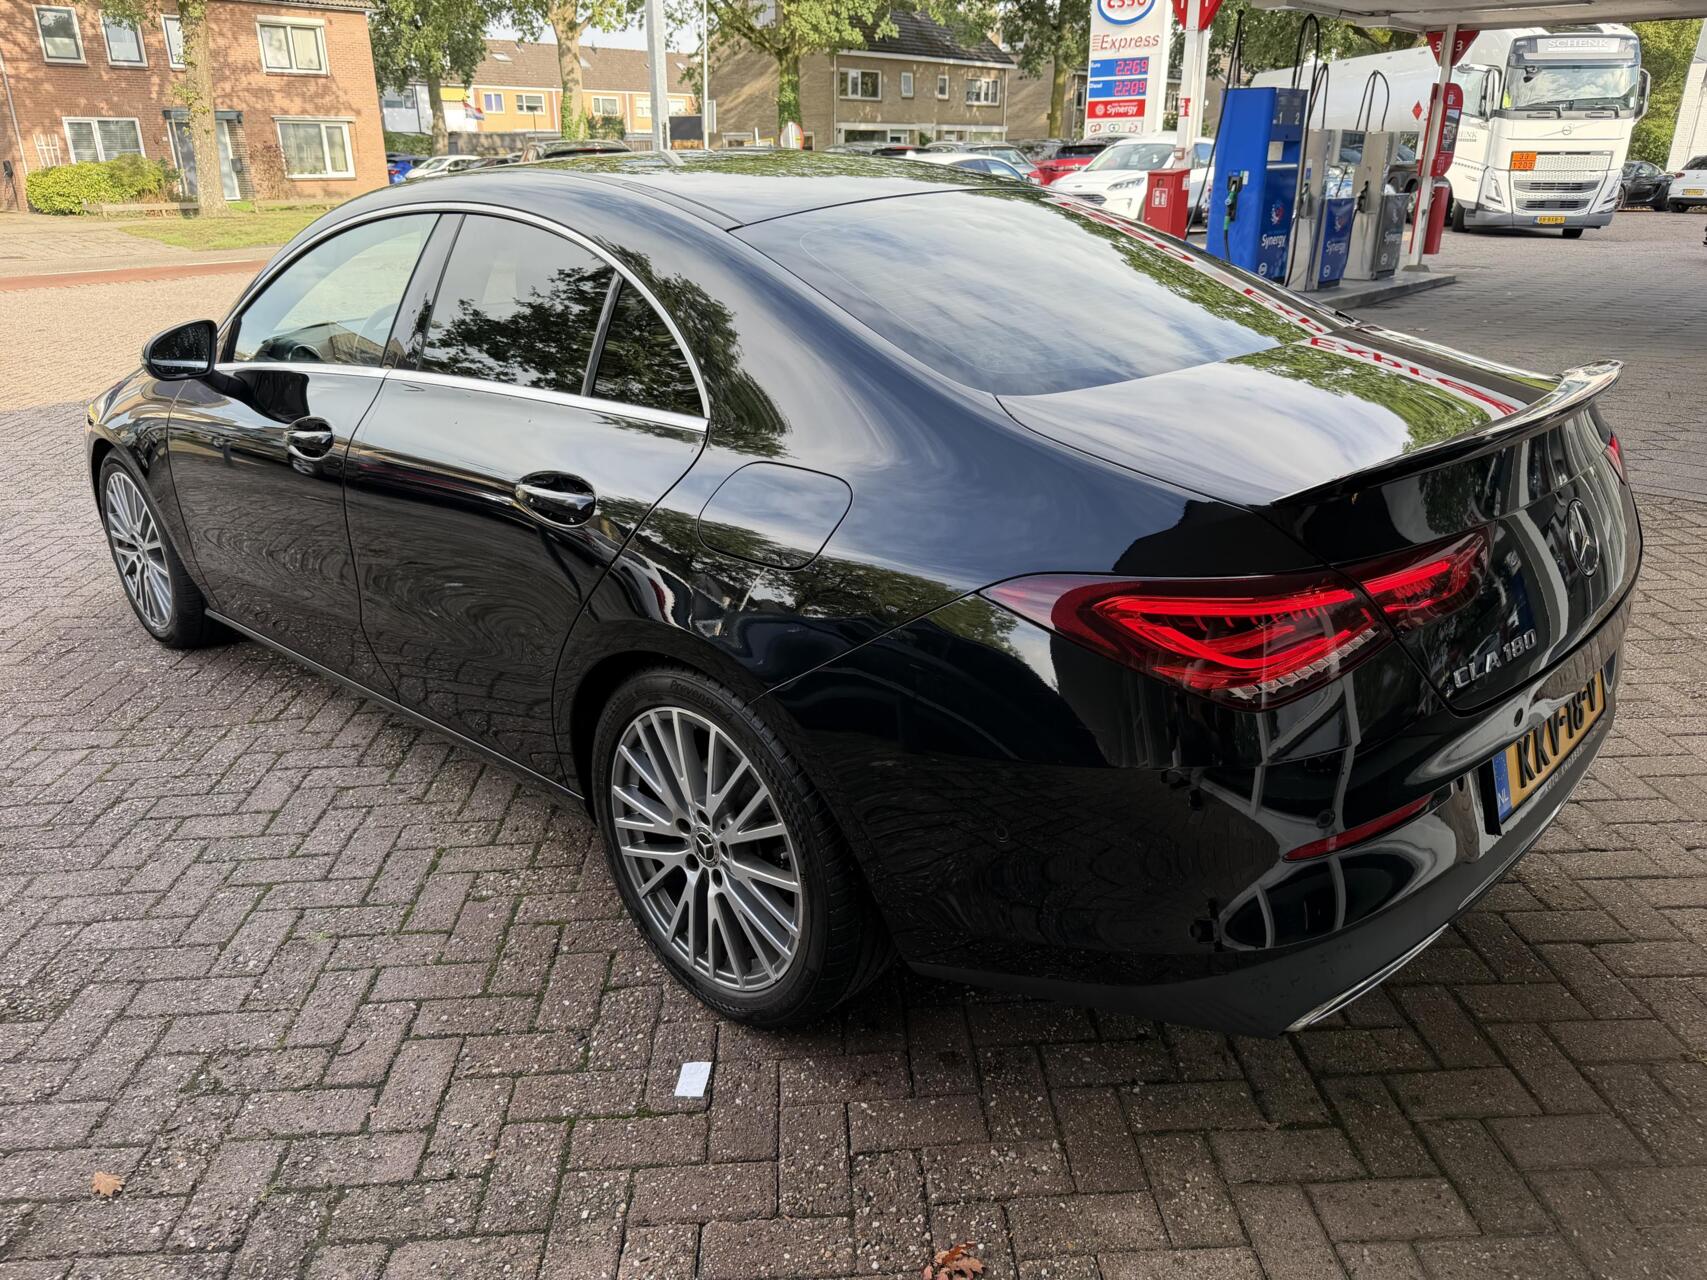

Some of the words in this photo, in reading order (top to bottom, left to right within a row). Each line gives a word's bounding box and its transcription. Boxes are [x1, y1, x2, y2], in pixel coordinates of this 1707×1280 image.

[1100, 34, 1160, 52] Express
[1435, 41, 1442, 52] 3
[1456, 40, 1464, 51] 3
[1548, 39, 1609, 48] SCHENK
[1106, 104, 1138, 116] Synergy
[1513, 161, 1533, 169] 1203
[1261, 234, 1287, 249] Synergy
[1453, 650, 1502, 688] CLA
[1502, 629, 1537, 662] 180
[1516, 676, 1597, 789] KKV-18-V
[1497, 788, 1509, 804] NL
